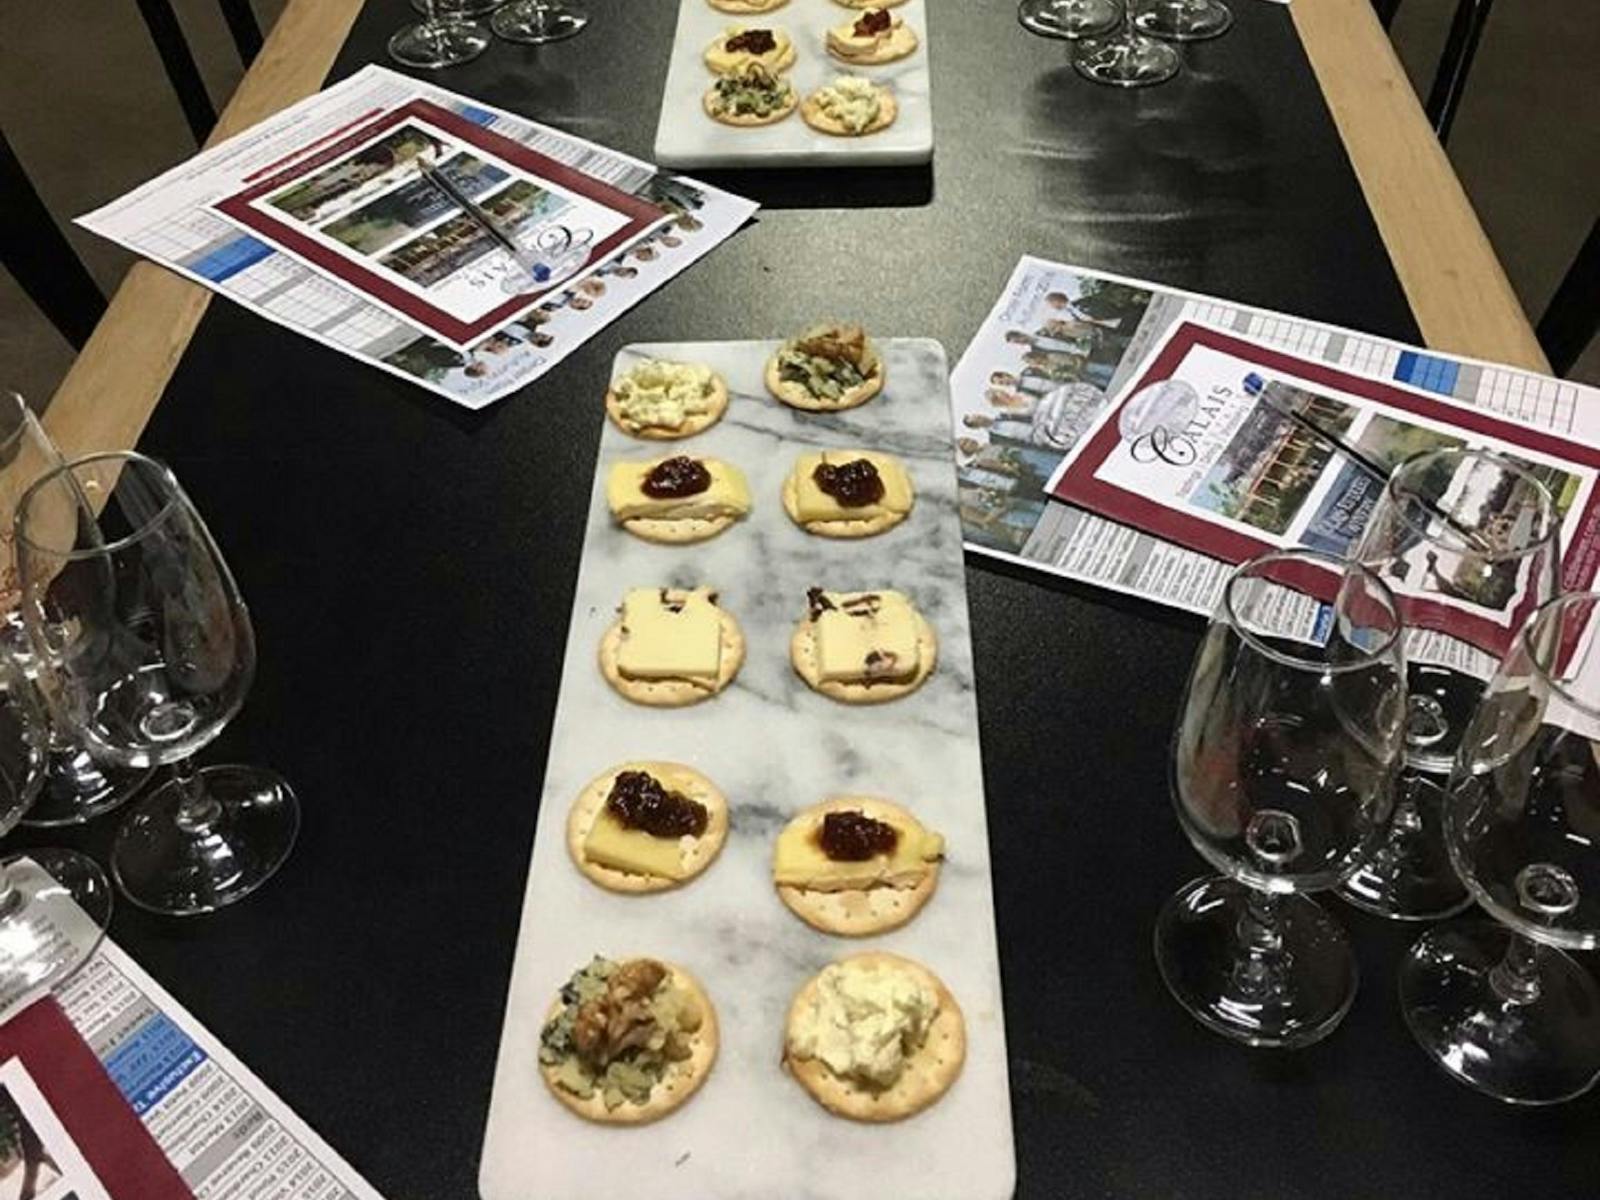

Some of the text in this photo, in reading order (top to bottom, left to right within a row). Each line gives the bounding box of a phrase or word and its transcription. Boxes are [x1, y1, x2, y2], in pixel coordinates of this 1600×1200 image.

[1132, 381, 1234, 465] CALAIS
[144, 1049, 202, 1102] Exclusive
[187, 1120, 226, 1156] Merlot
[230, 1109, 265, 1142] Reds
